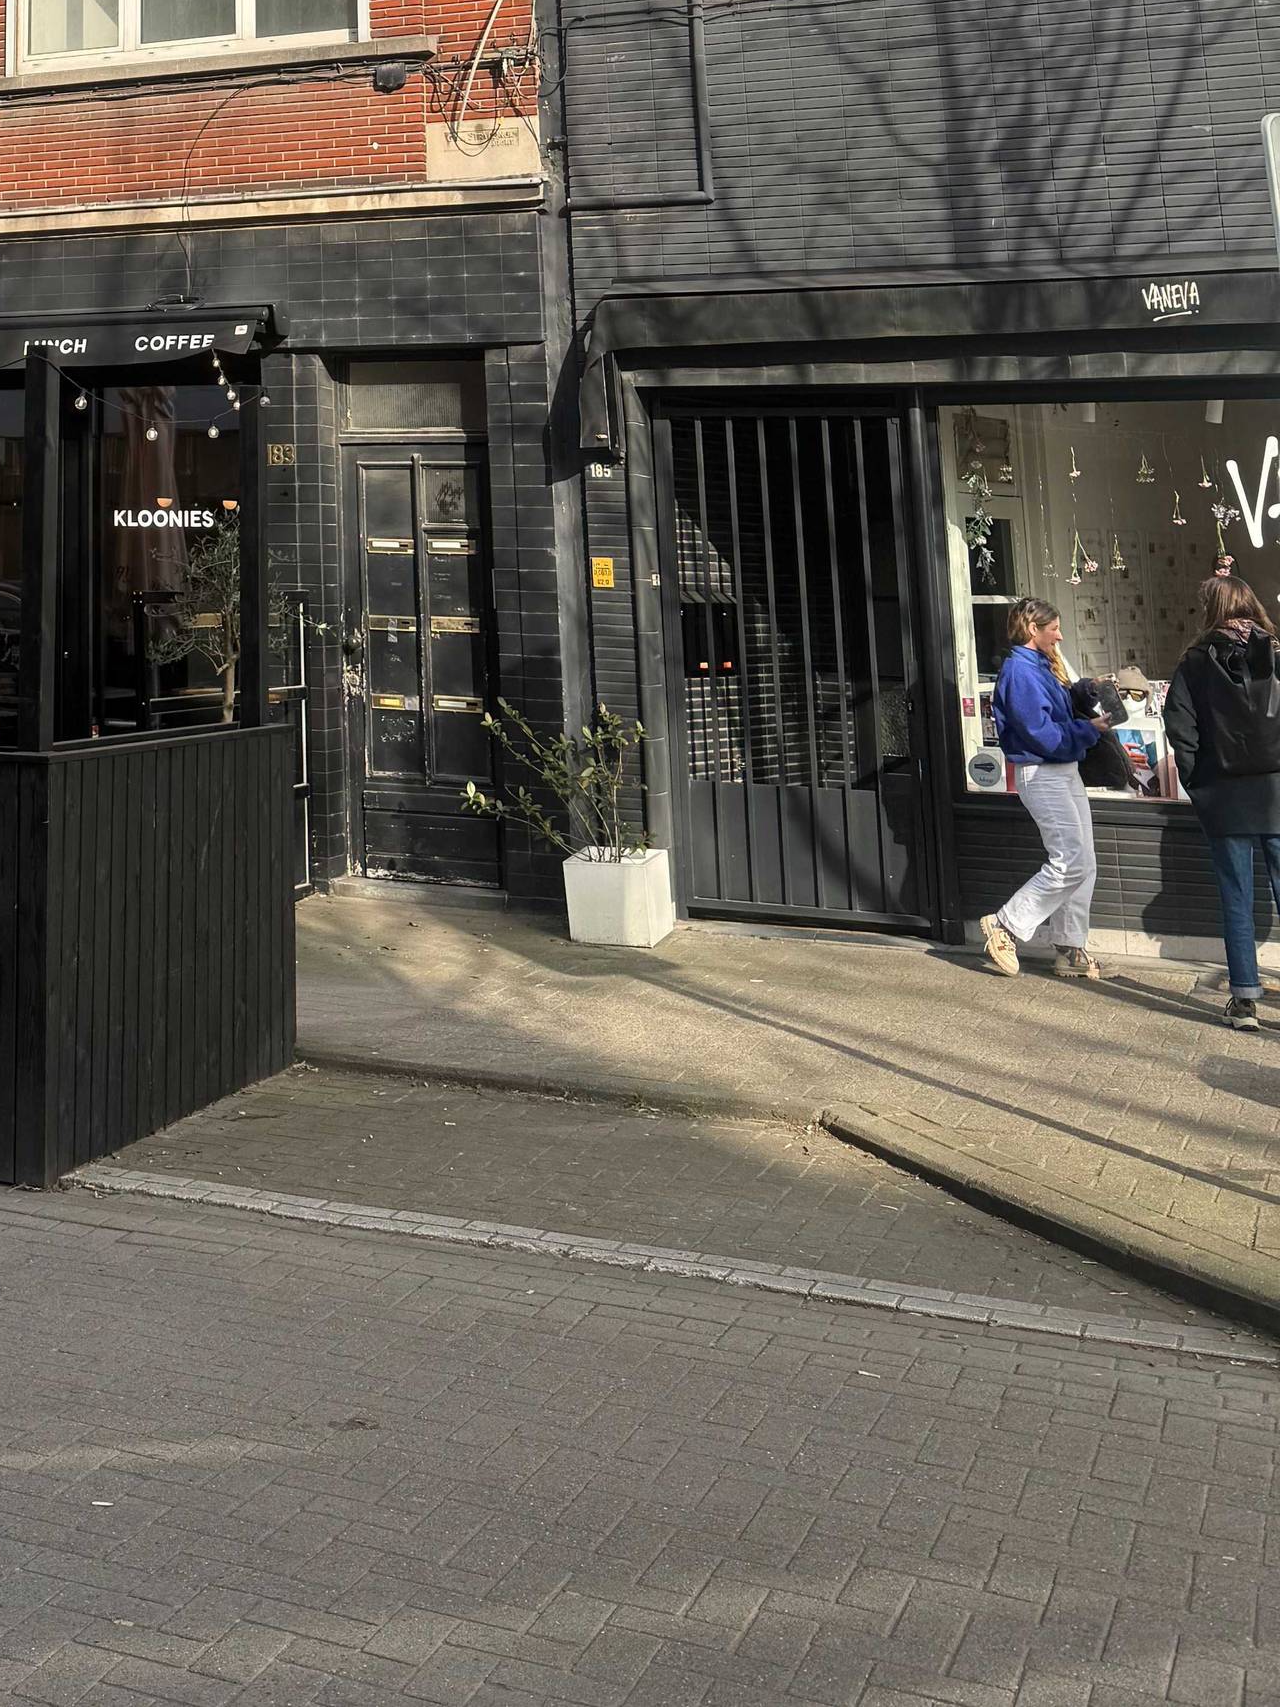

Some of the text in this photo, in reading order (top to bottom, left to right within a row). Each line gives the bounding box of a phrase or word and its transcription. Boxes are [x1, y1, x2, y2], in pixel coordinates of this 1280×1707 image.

[1141, 281, 1200, 313] VANEVA
[135, 334, 215, 352] COFFEE
[267, 444, 295, 466] 183
[590, 463, 612, 478] 185
[113, 509, 215, 528] KLOONIES
